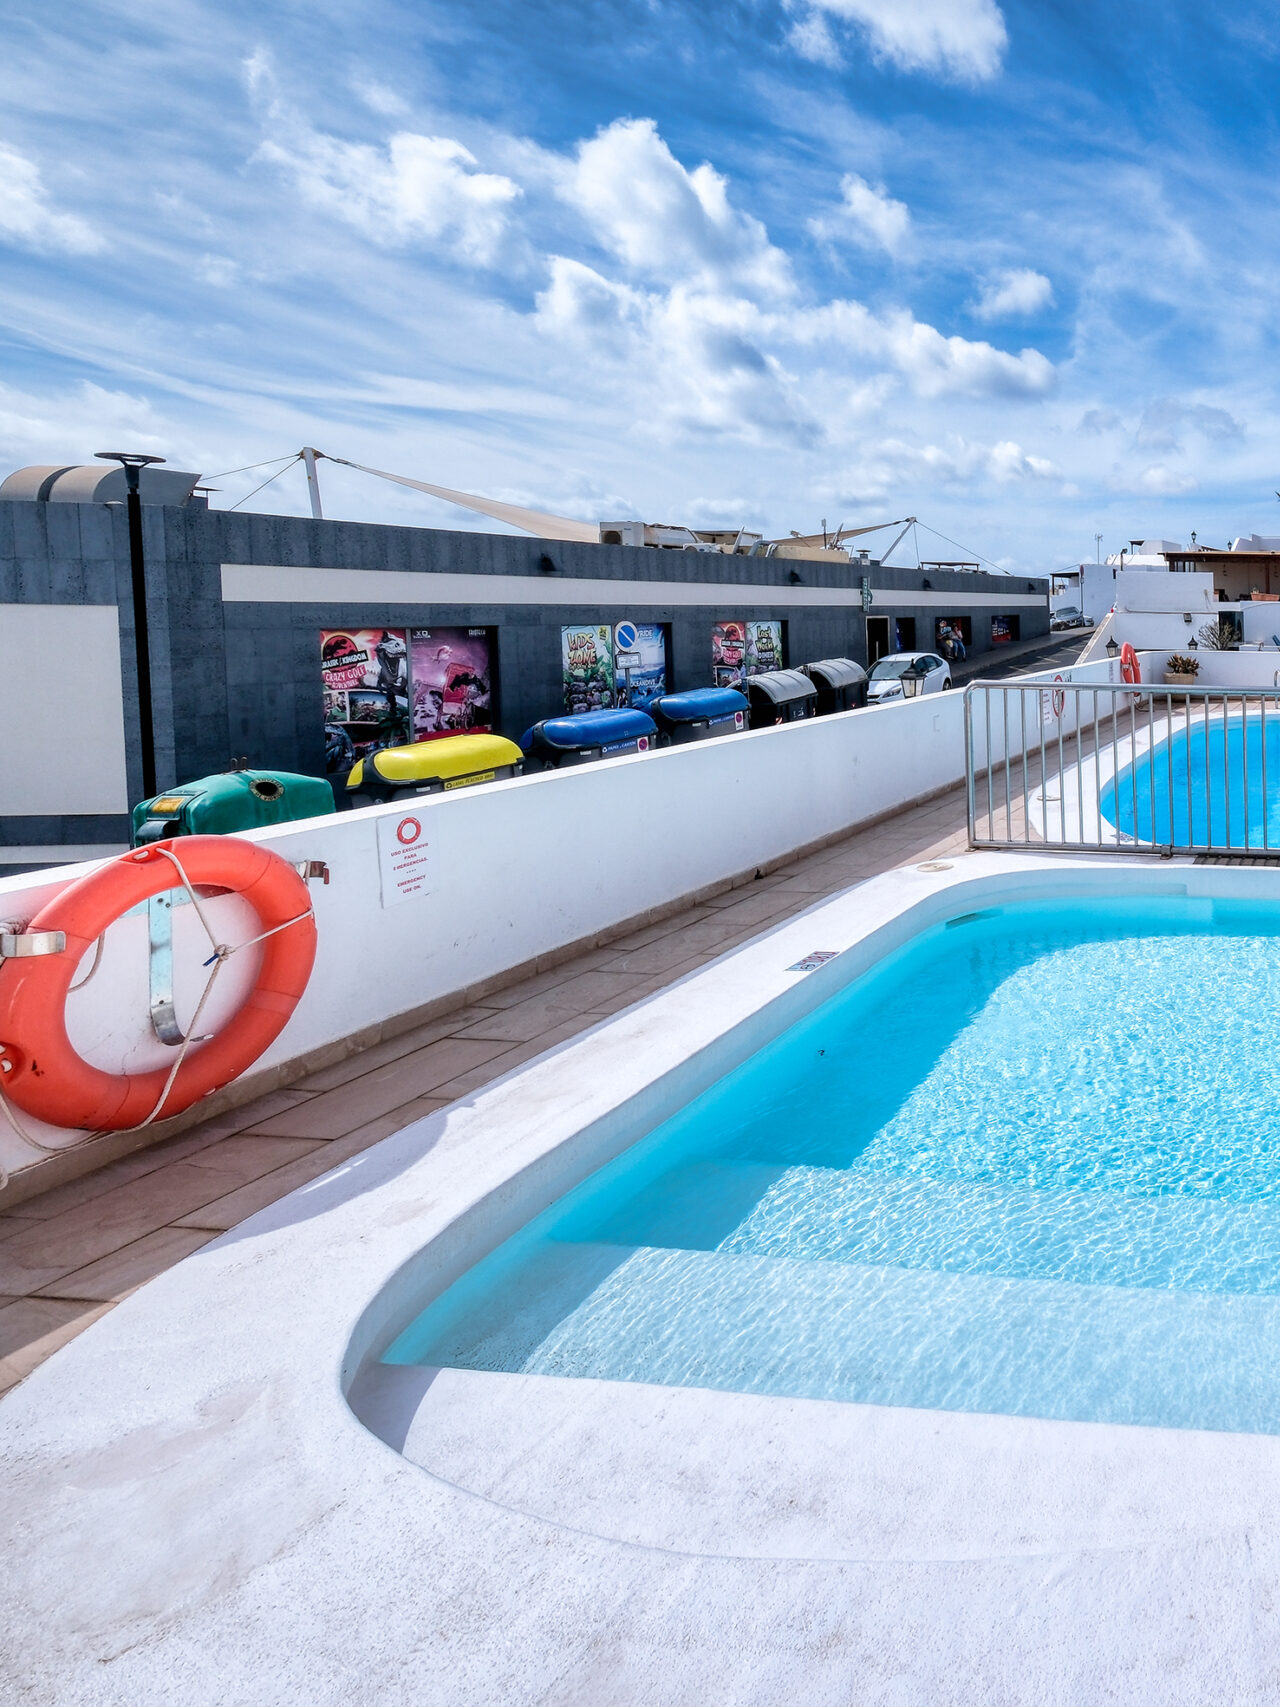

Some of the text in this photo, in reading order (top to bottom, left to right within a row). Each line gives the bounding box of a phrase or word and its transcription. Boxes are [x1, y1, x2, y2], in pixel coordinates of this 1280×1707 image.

[566, 632, 596, 651] KIDS
[568, 648, 597, 666] ZONE
[325, 665, 365, 682] CRAZY GOLF
[402, 842, 429, 853] EXCLUSIVO
[397, 875, 426, 887] EMERGENCY
